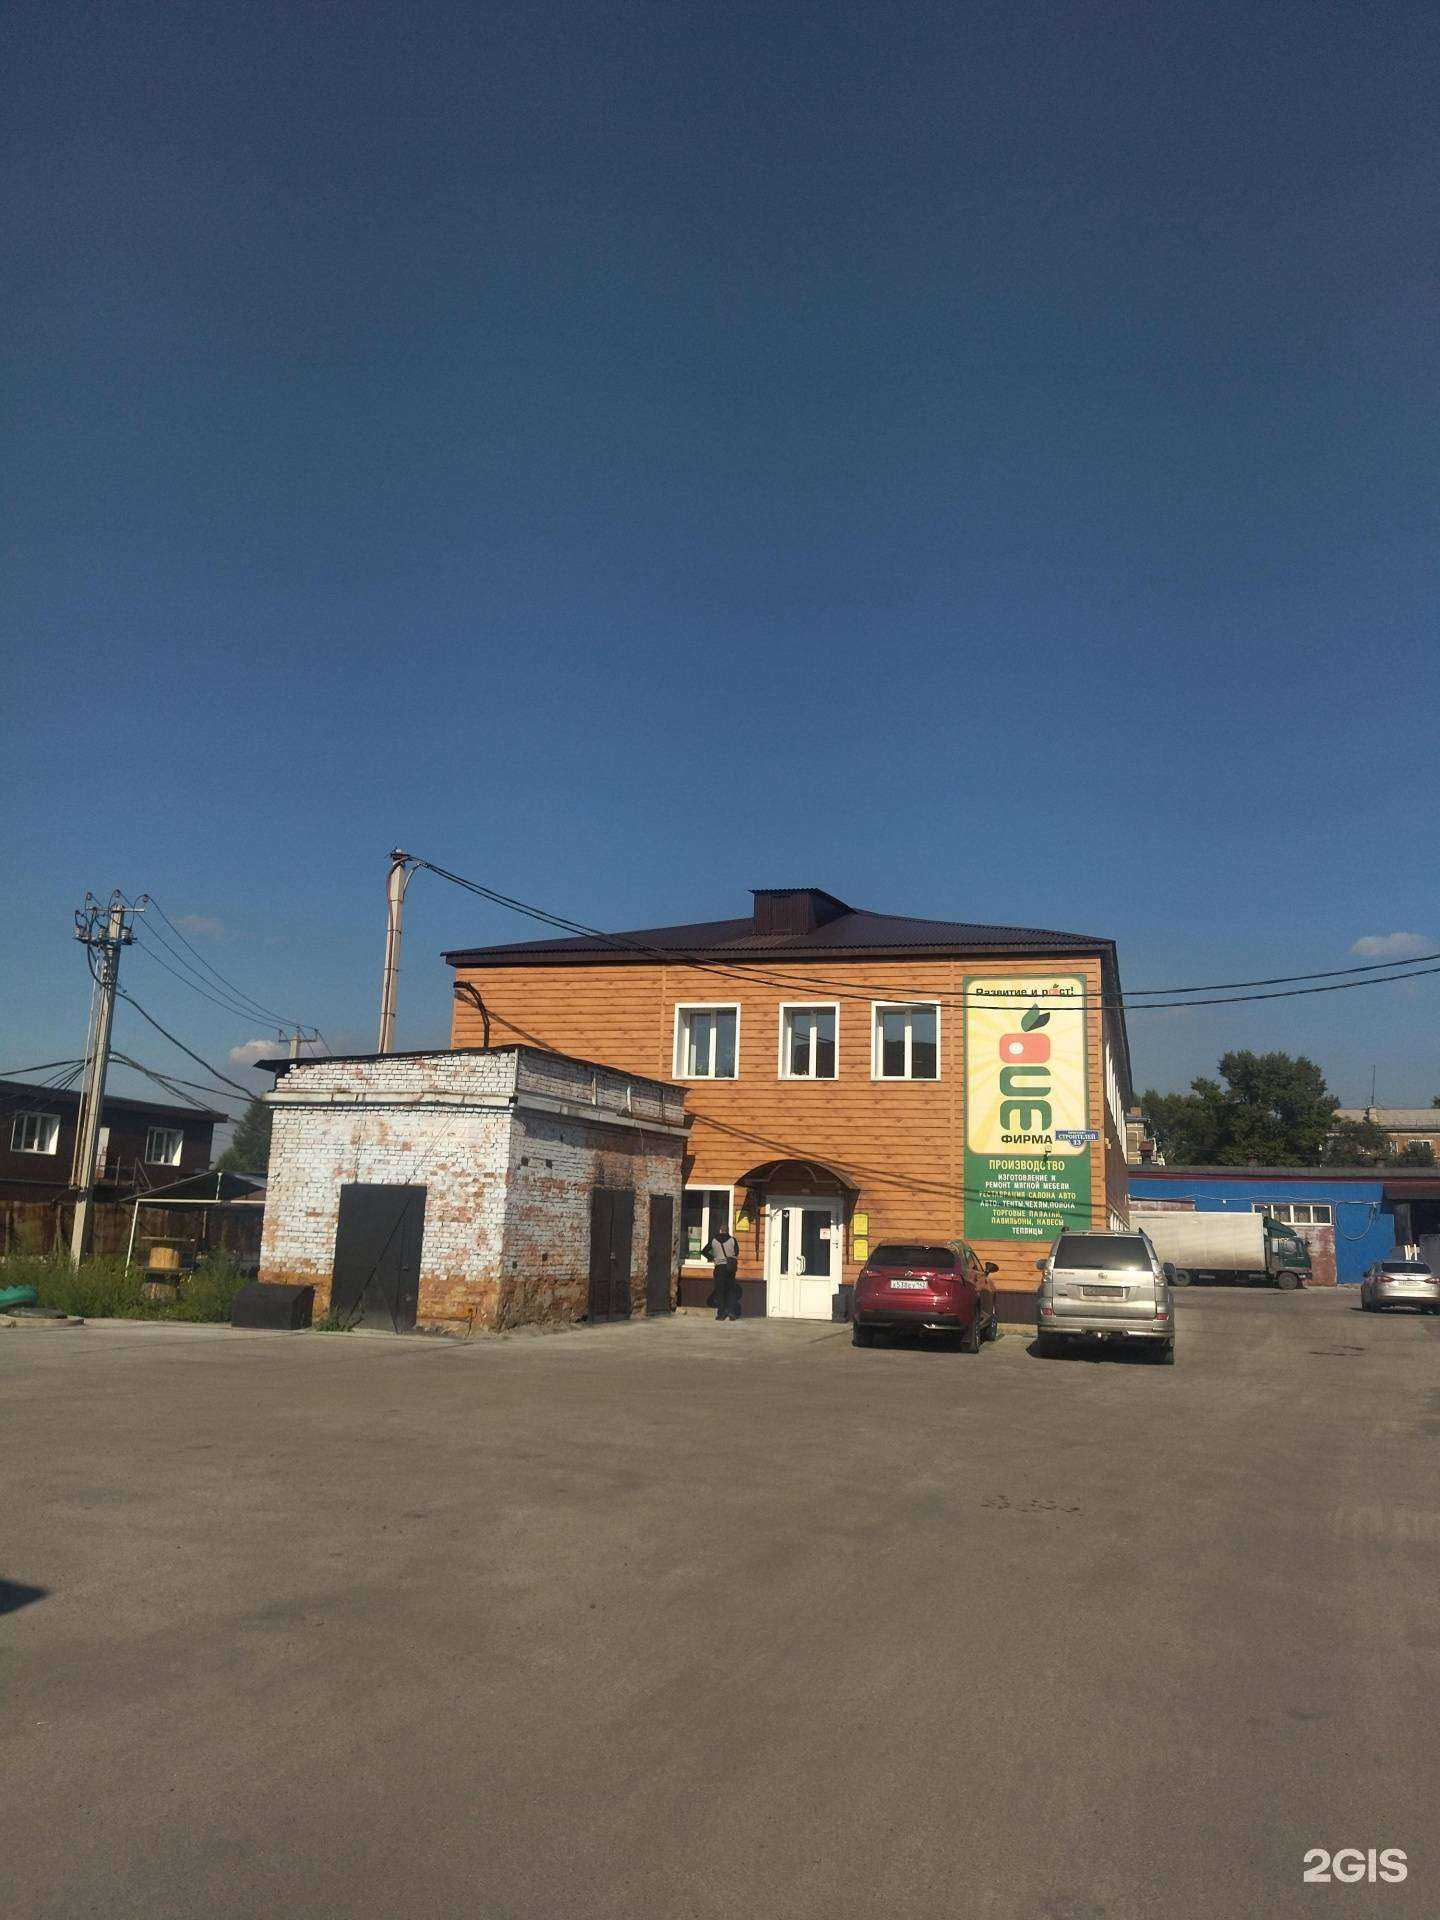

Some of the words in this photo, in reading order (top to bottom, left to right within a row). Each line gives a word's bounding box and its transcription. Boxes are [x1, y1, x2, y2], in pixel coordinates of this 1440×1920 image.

[1001, 1134, 1053, 1144] ФИРМА
[989, 1160, 1065, 1172] ПРОИЗВОДСТВО
[1013, 1182, 1040, 1190] МЯГКОЙ
[992, 1209, 1026, 1217] ТОРГОВЫЕ
[1012, 1227, 1043, 1236] ТЕПЛИЦЫ
